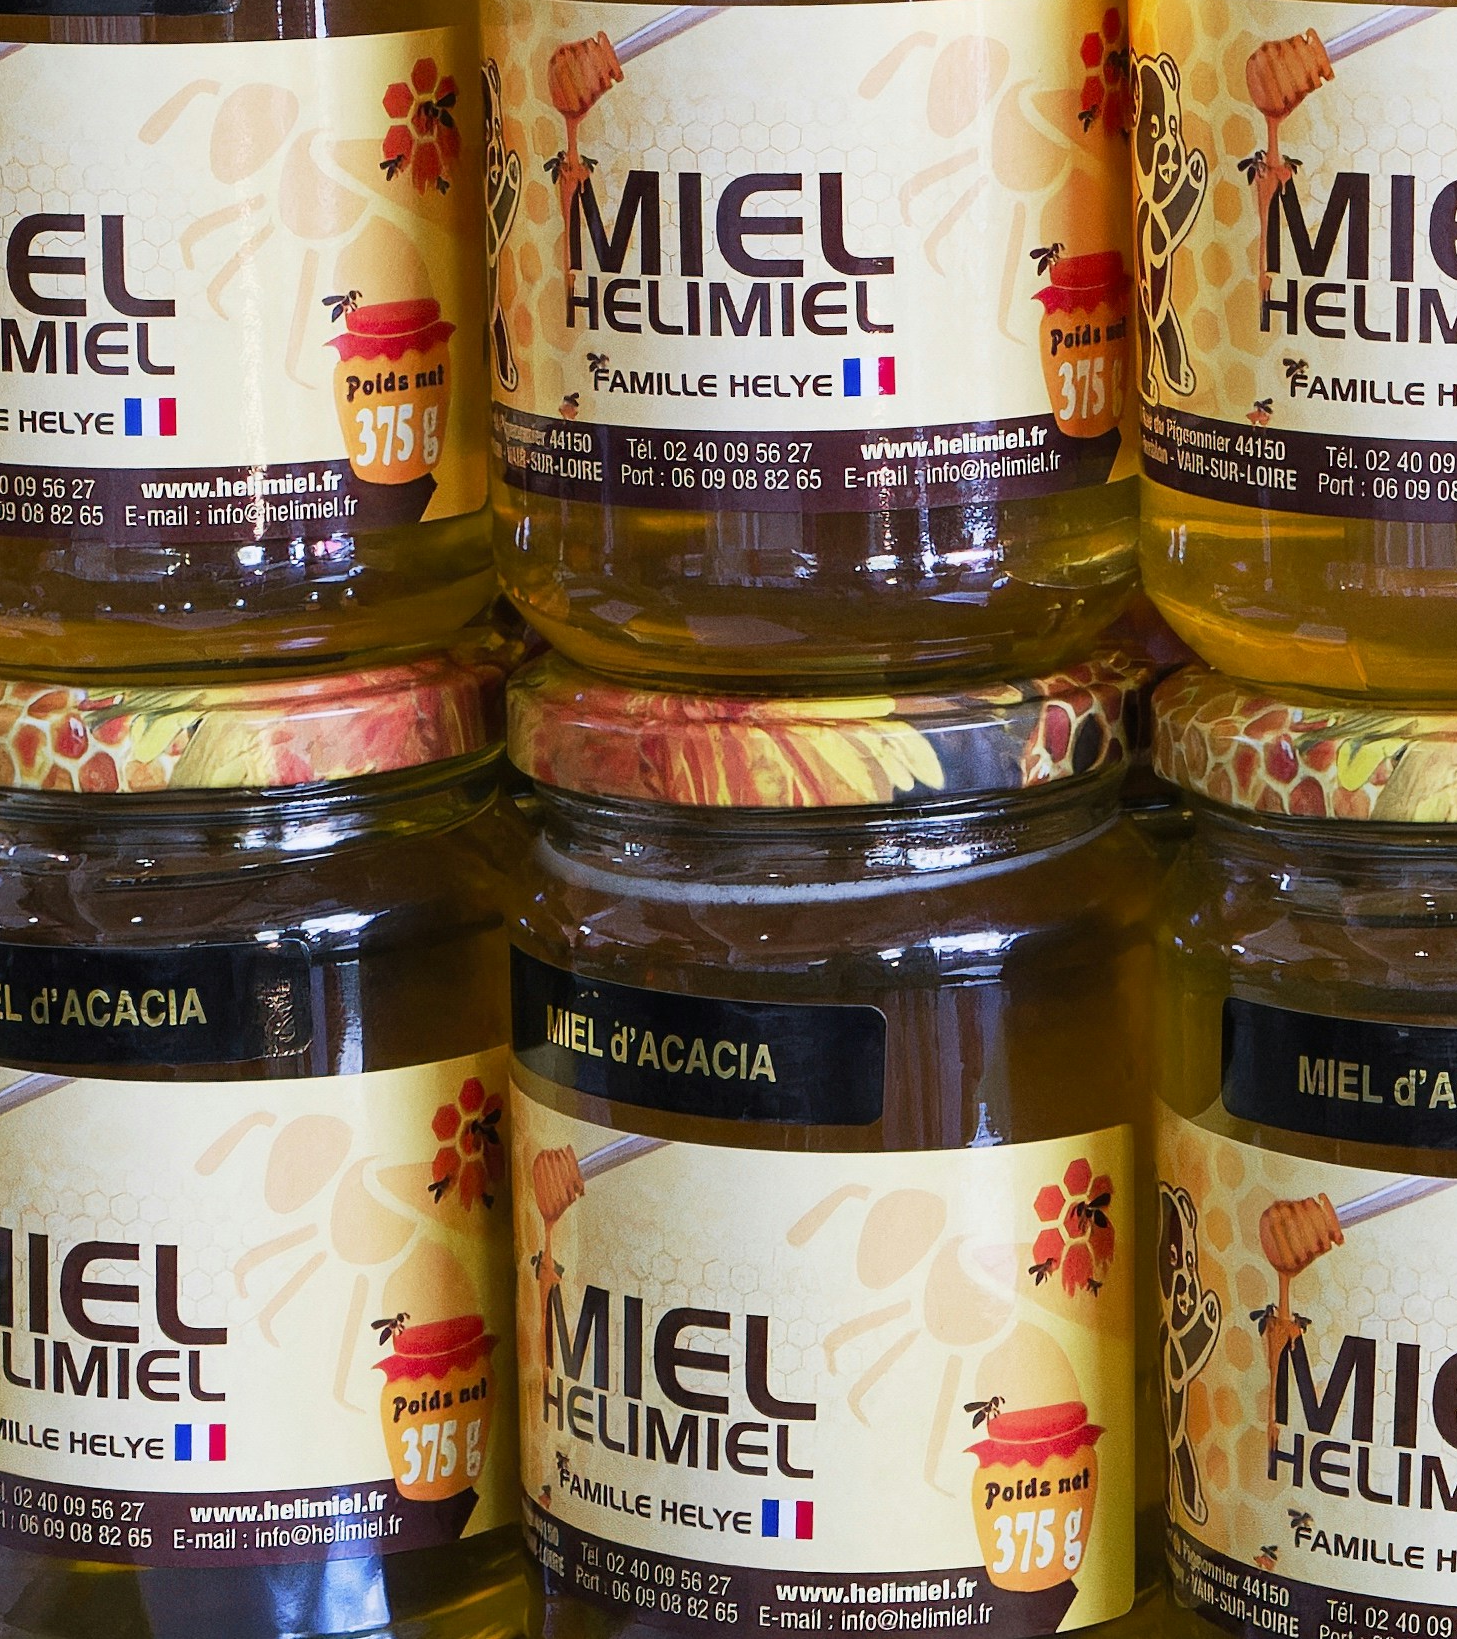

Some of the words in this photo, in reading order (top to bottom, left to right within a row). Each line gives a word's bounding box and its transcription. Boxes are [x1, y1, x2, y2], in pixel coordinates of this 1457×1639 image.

[570, 170, 894, 276] MIEL
[567, 276, 894, 337] HELIMIEL
[593, 368, 716, 398] FAMILLE
[729, 372, 833, 398] HELYE
[1291, 374, 1425, 407] FAMILLE
[1166, 420, 1230, 453] Pigeonnier
[1235, 434, 1286, 461] 44150
[1176, 449, 1297, 491] VAIR-SUR-LOIRE
[31, 987, 207, 1027] d'ACACIA
[546, 1004, 603, 1058] MIEL
[609, 1024, 776, 1082] d'ACACIA
[1298, 1056, 1383, 1104] MIEL
[546, 1282, 816, 1421] MIEL
[544, 1384, 814, 1480] HELIMIEL
[985, 1476, 1051, 1509] Poids
[1058, 1468, 1090, 1493] net
[992, 1510, 1053, 1574] 375
[1063, 1507, 1083, 1571] g
